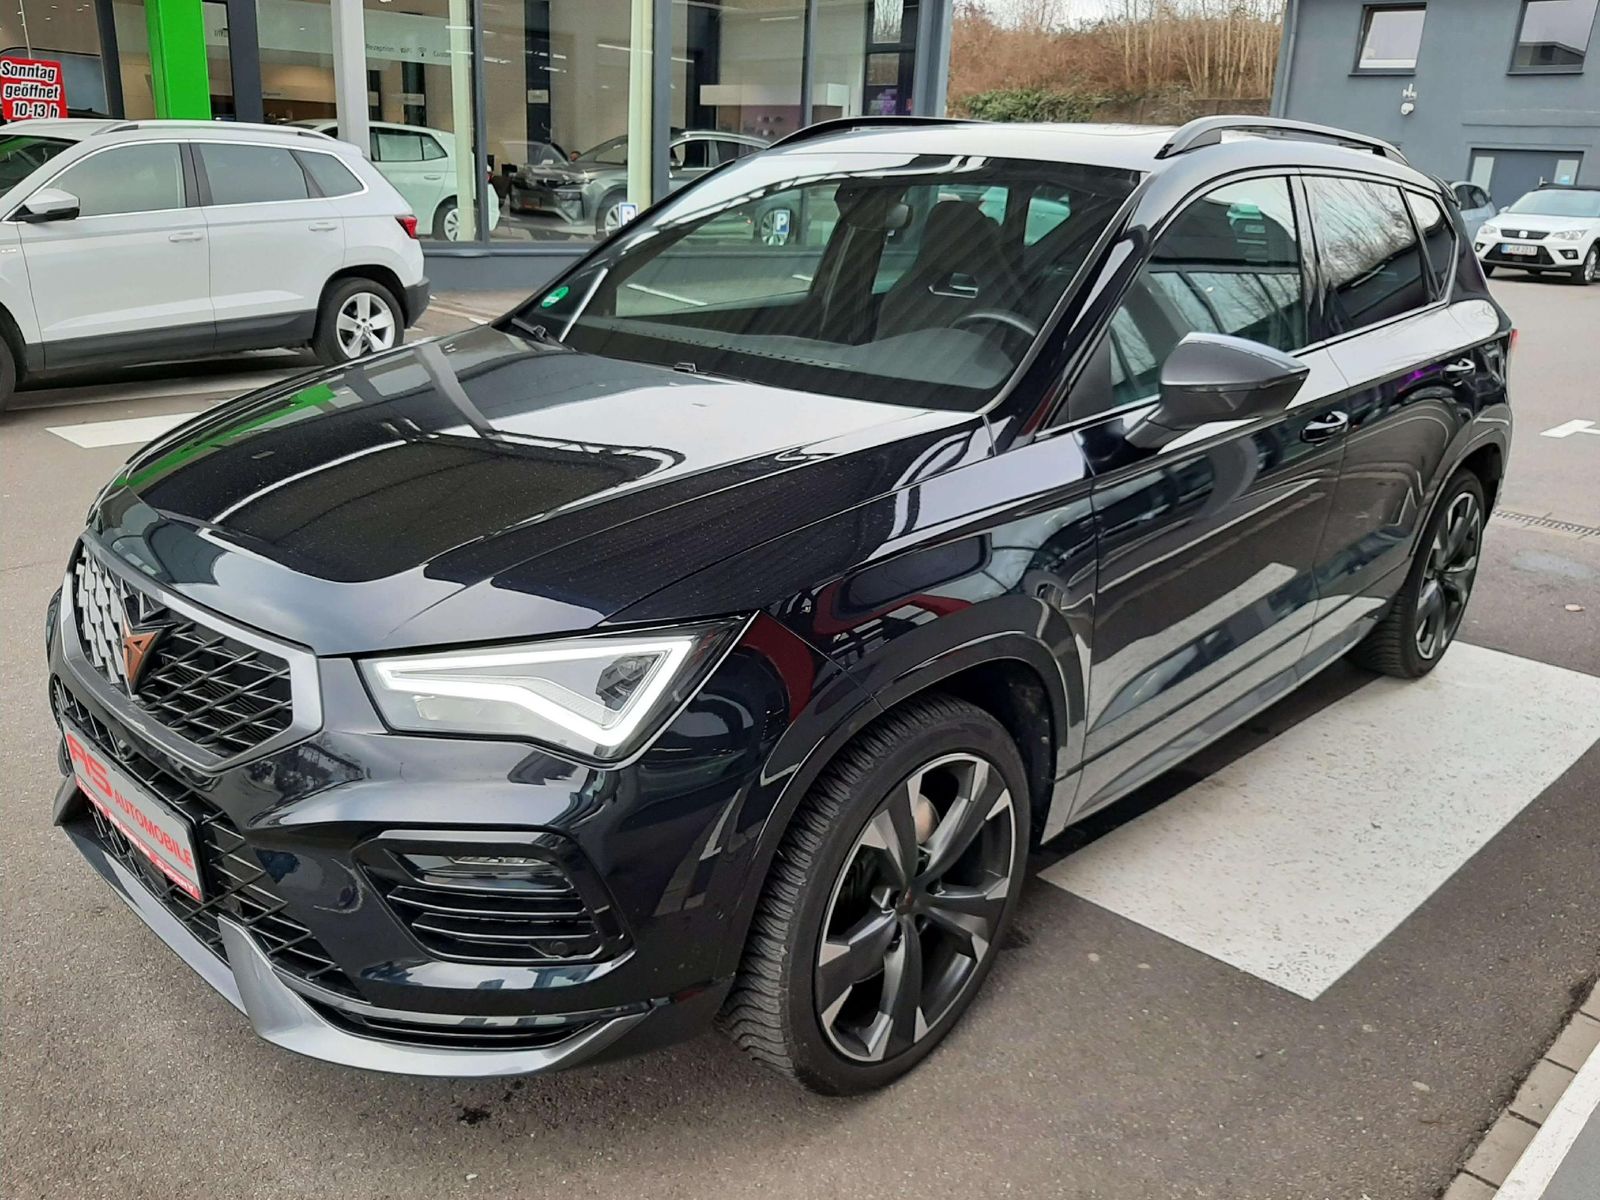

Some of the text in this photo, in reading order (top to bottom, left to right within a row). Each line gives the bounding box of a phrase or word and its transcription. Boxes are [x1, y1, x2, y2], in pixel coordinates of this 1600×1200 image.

[1, 61, 56, 82] Sonntag
[4, 83, 59, 99] geöffnet
[14, 102, 58, 119] 10-13 h
[775, 212, 788, 232] P
[114, 788, 194, 870] AUTOMOBILE
